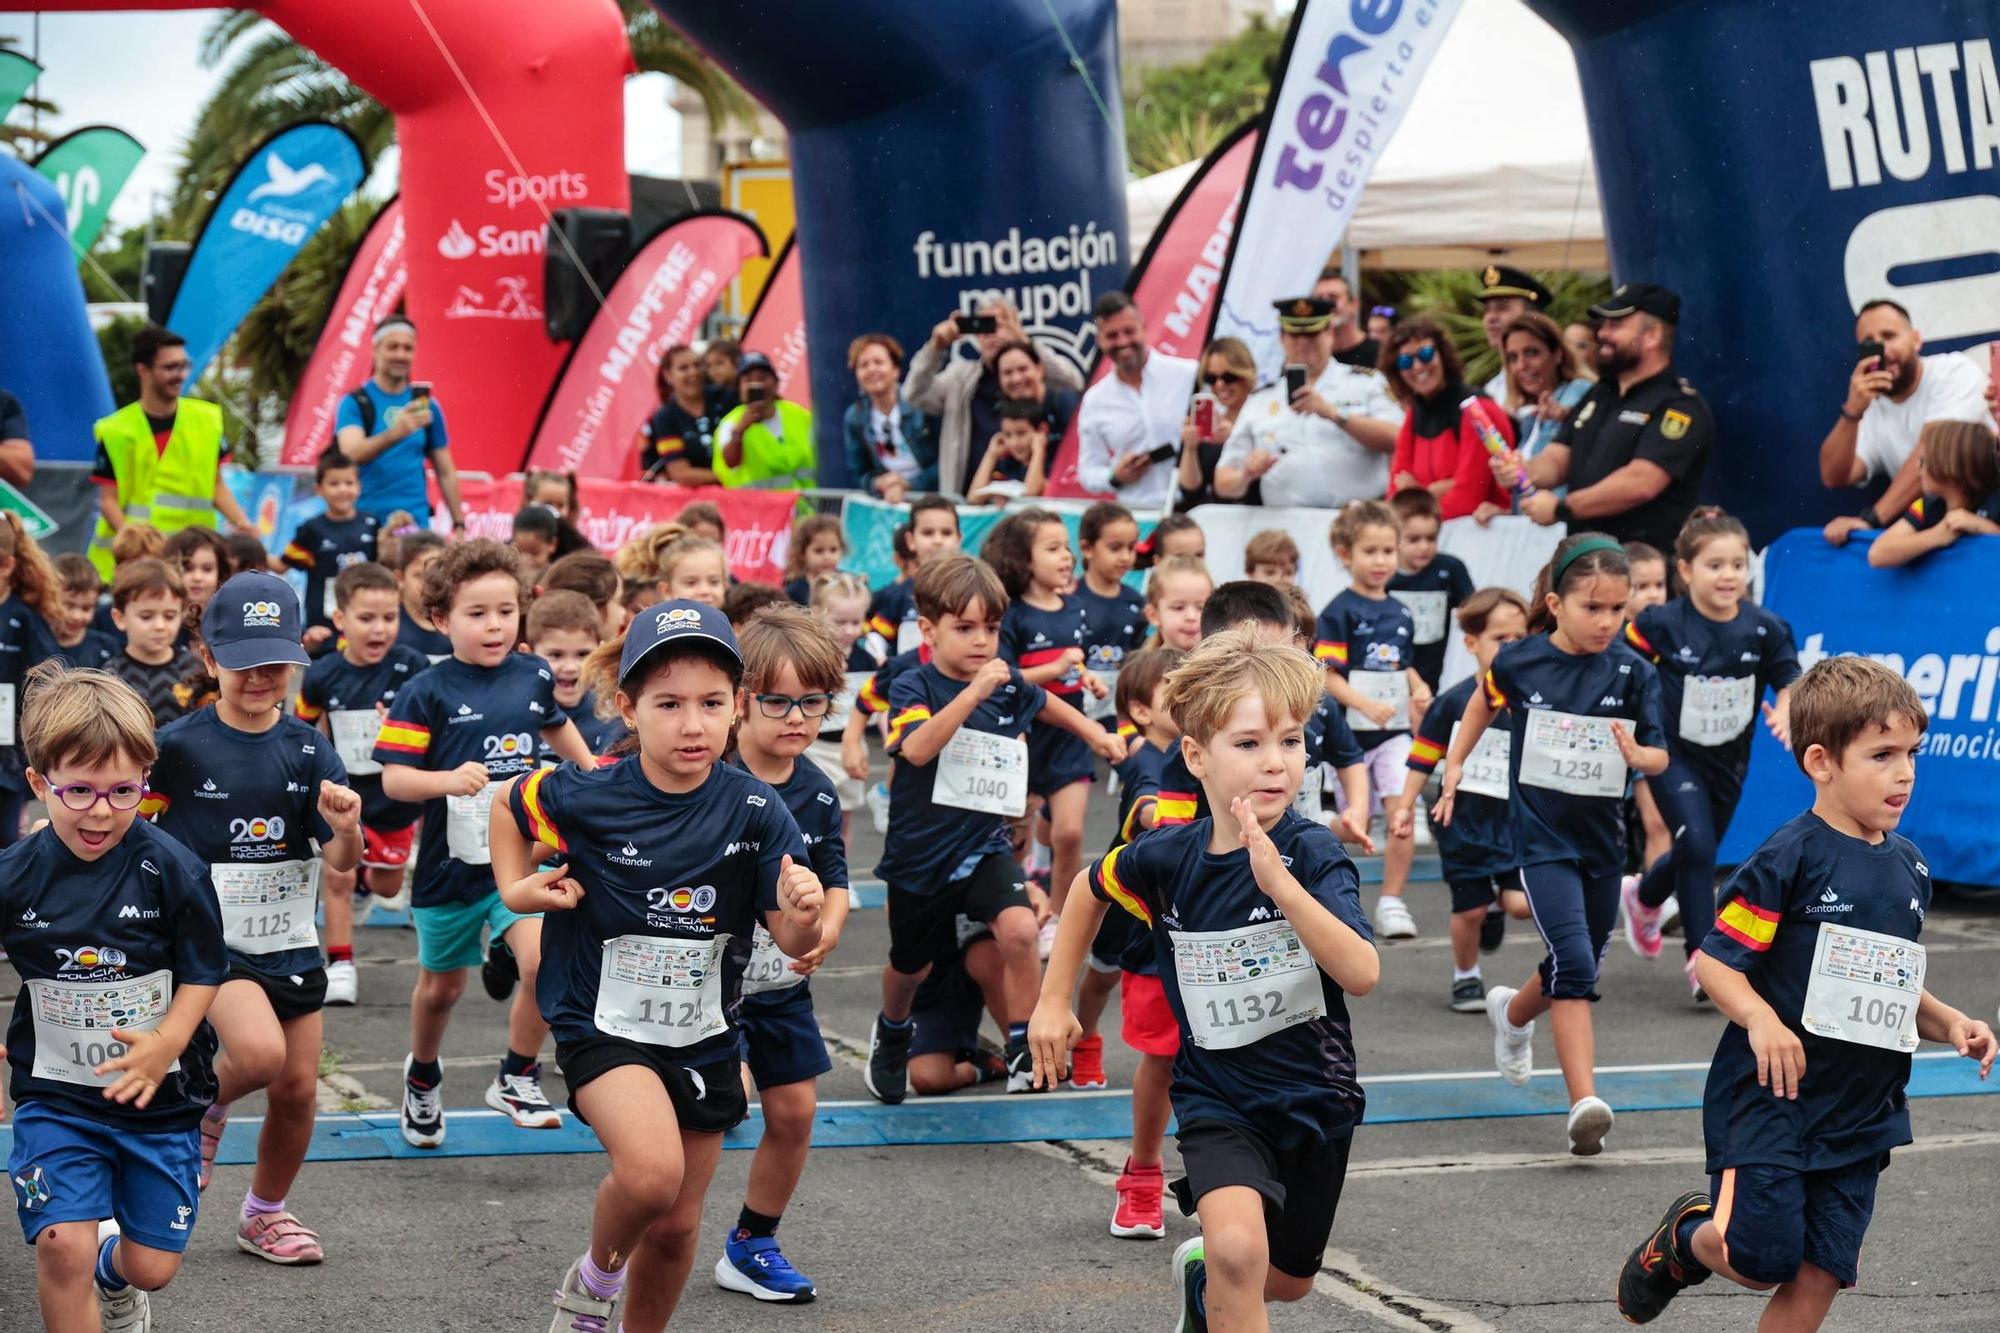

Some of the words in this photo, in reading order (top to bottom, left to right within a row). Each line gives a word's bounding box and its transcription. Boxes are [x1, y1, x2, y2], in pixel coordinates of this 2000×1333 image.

[1324, 40, 1413, 211] despierta
[1809, 38, 2000, 190] RUTA
[484, 169, 588, 210] Sports
[913, 221, 1118, 279] fundación
[600, 240, 697, 382] MAPFRE
[243, 601, 281, 617] 200
[656, 609, 702, 627] 200
[1701, 716, 1739, 733] 1100
[483, 732, 533, 759] 200
[1551, 759, 1604, 781] 1234
[193, 789, 230, 799] Santander
[964, 776, 1009, 801] 1040
[229, 815, 285, 843] 200
[230, 843, 277, 853] POLICIA
[231, 850, 287, 859] NACIONAL
[606, 853, 653, 867] Santander
[646, 884, 717, 914] 200
[1805, 903, 1854, 914] Santander
[242, 911, 292, 938] 1125
[646, 912, 702, 924] POLICIA
[54, 945, 127, 971] 200
[56, 966, 119, 980] POLICIA
[1205, 989, 1287, 1028] 1132
[1847, 995, 1908, 1031] 1067
